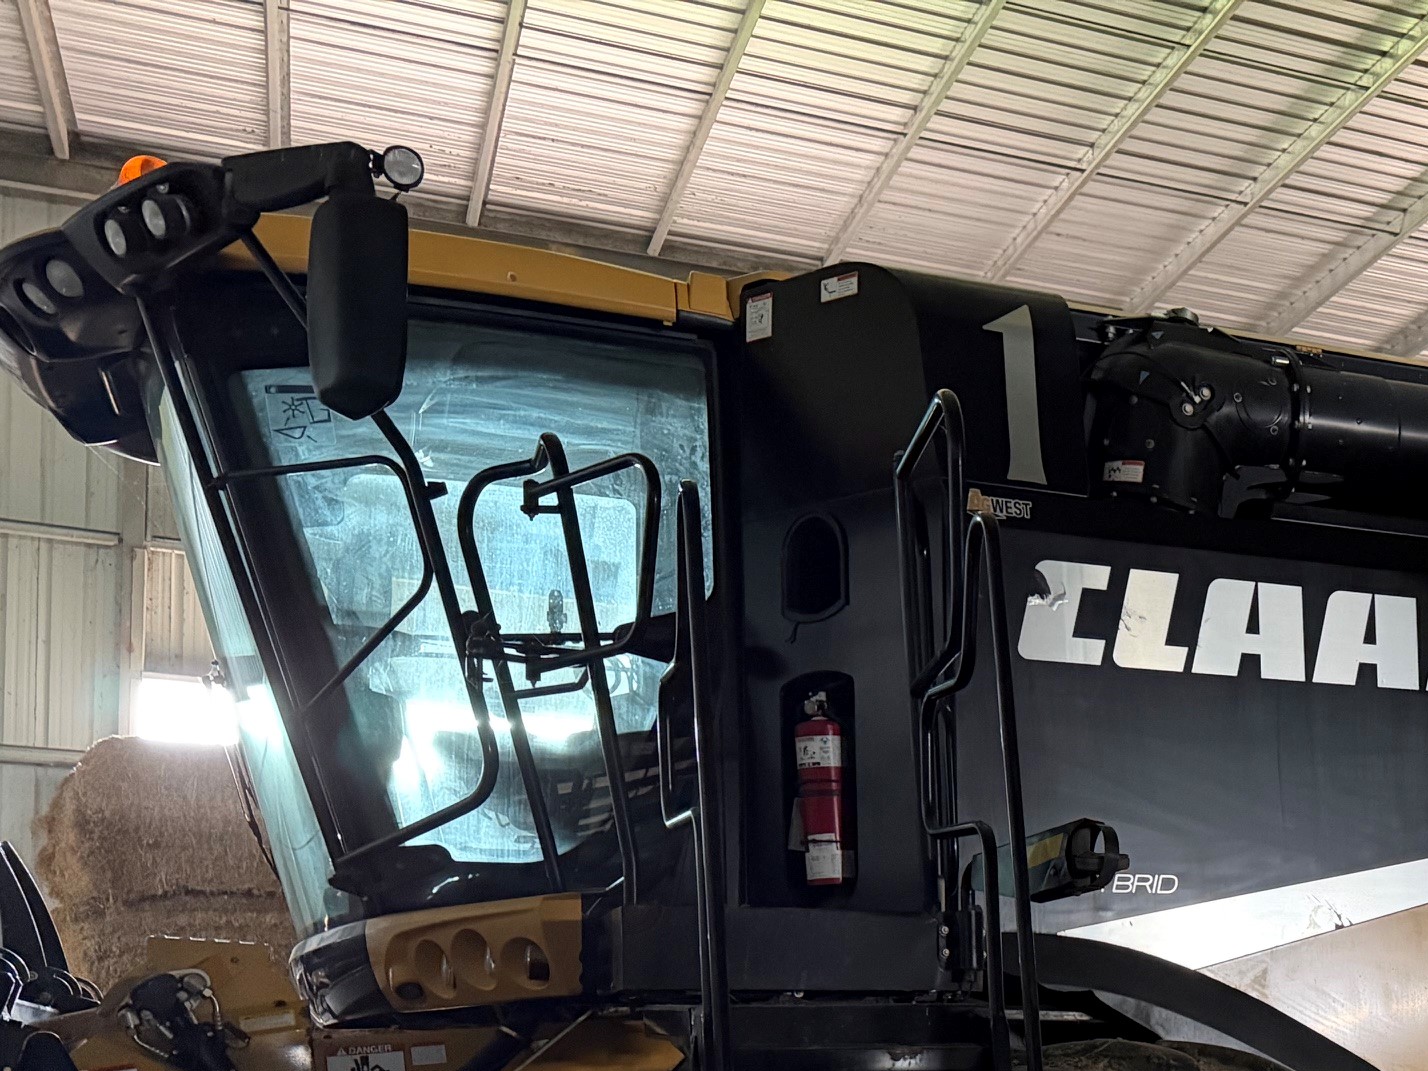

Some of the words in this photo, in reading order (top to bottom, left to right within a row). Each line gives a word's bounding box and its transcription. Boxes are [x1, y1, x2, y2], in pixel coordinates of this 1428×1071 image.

[982, 304, 1048, 485] 1
[1101, 873, 1179, 894] BRID
[349, 1044, 392, 1055] DANGER
